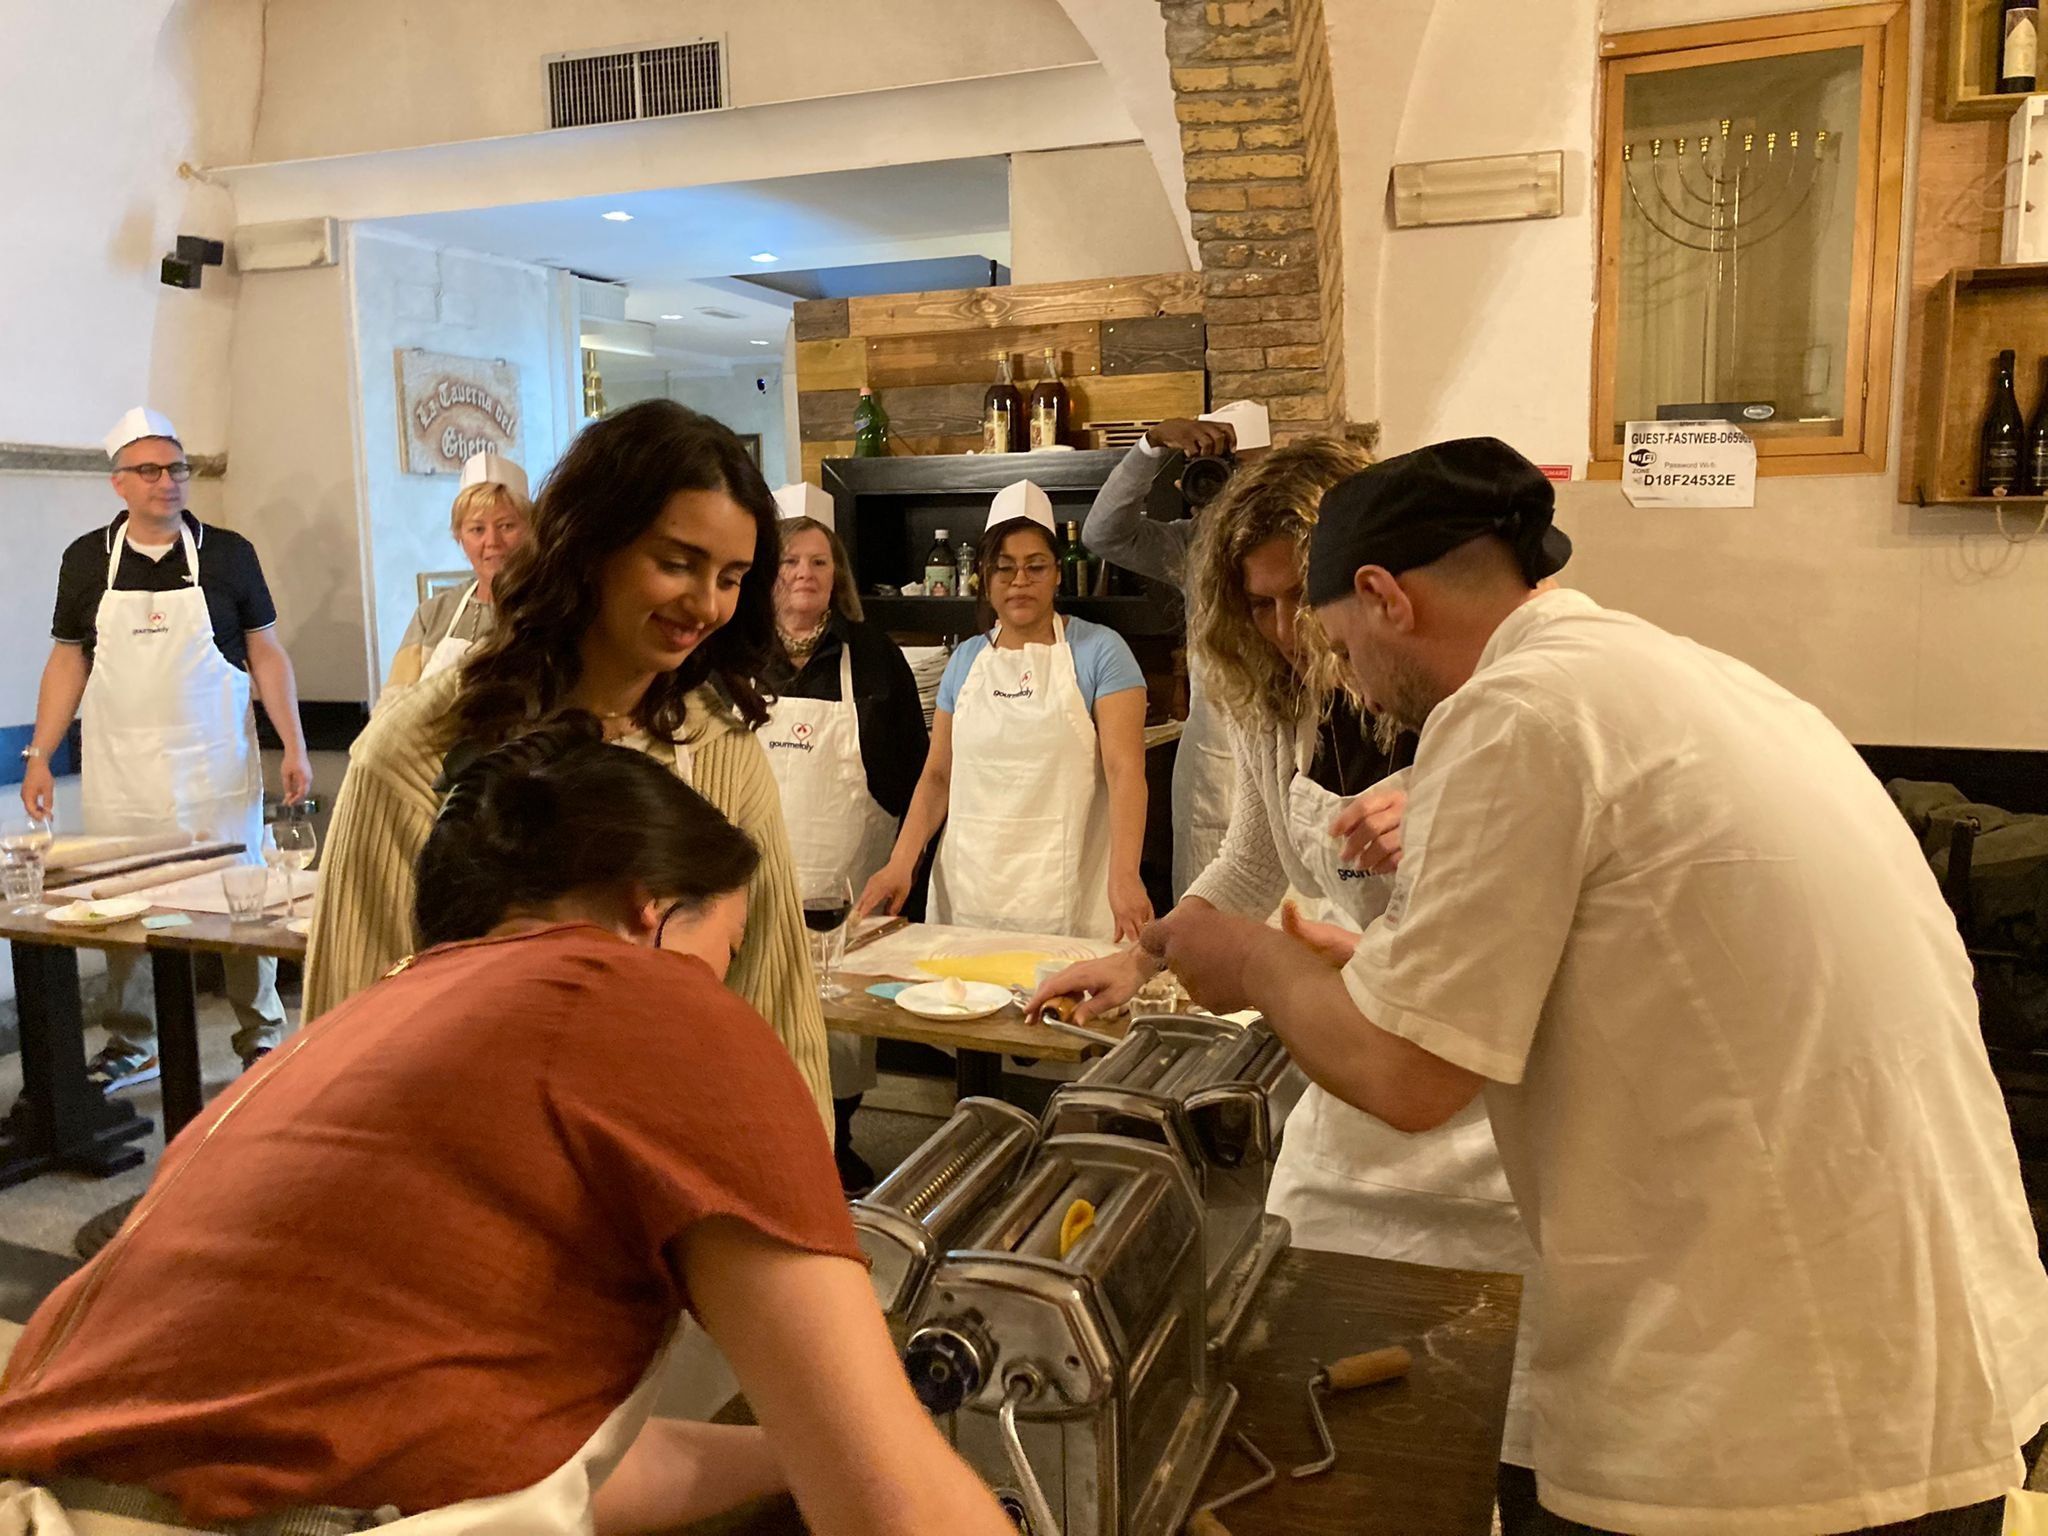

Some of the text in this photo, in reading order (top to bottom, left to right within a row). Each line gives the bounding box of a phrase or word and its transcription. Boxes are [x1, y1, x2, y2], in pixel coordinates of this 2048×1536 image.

[416, 400, 437, 429] La
[439, 381, 492, 414] Taverna
[1664, 461, 1698, 469] Password
[1644, 474, 1736, 486] D18F24532E
